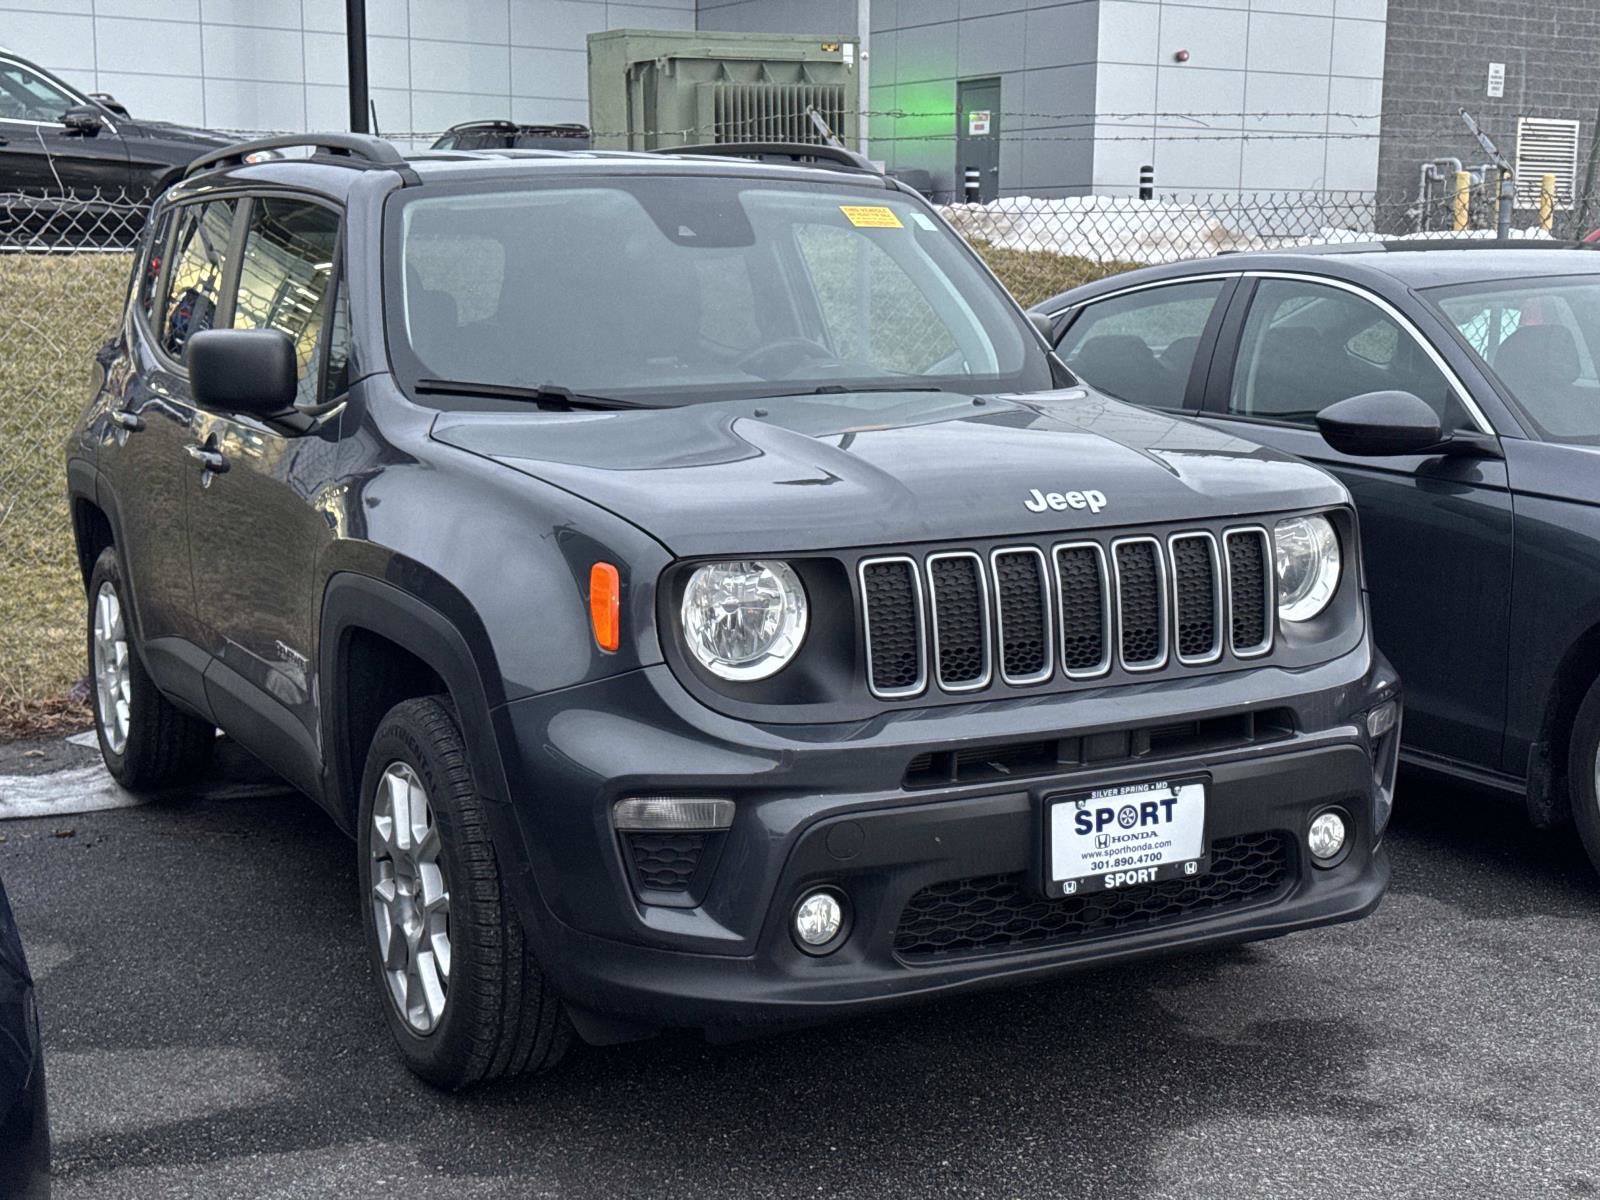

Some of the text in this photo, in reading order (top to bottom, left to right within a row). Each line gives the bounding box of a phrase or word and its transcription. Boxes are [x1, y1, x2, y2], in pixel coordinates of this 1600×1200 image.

[1023, 488, 1107, 513] Jeep
[1091, 781, 1168, 799] SILVER SPRING MD
[1074, 798, 1178, 835] SPORT
[1111, 830, 1158, 843] HONDA
[1081, 840, 1172, 860] www.sporthonda.com
[1091, 852, 1162, 871] 301.890.4700
[1104, 867, 1158, 888] SPORT
